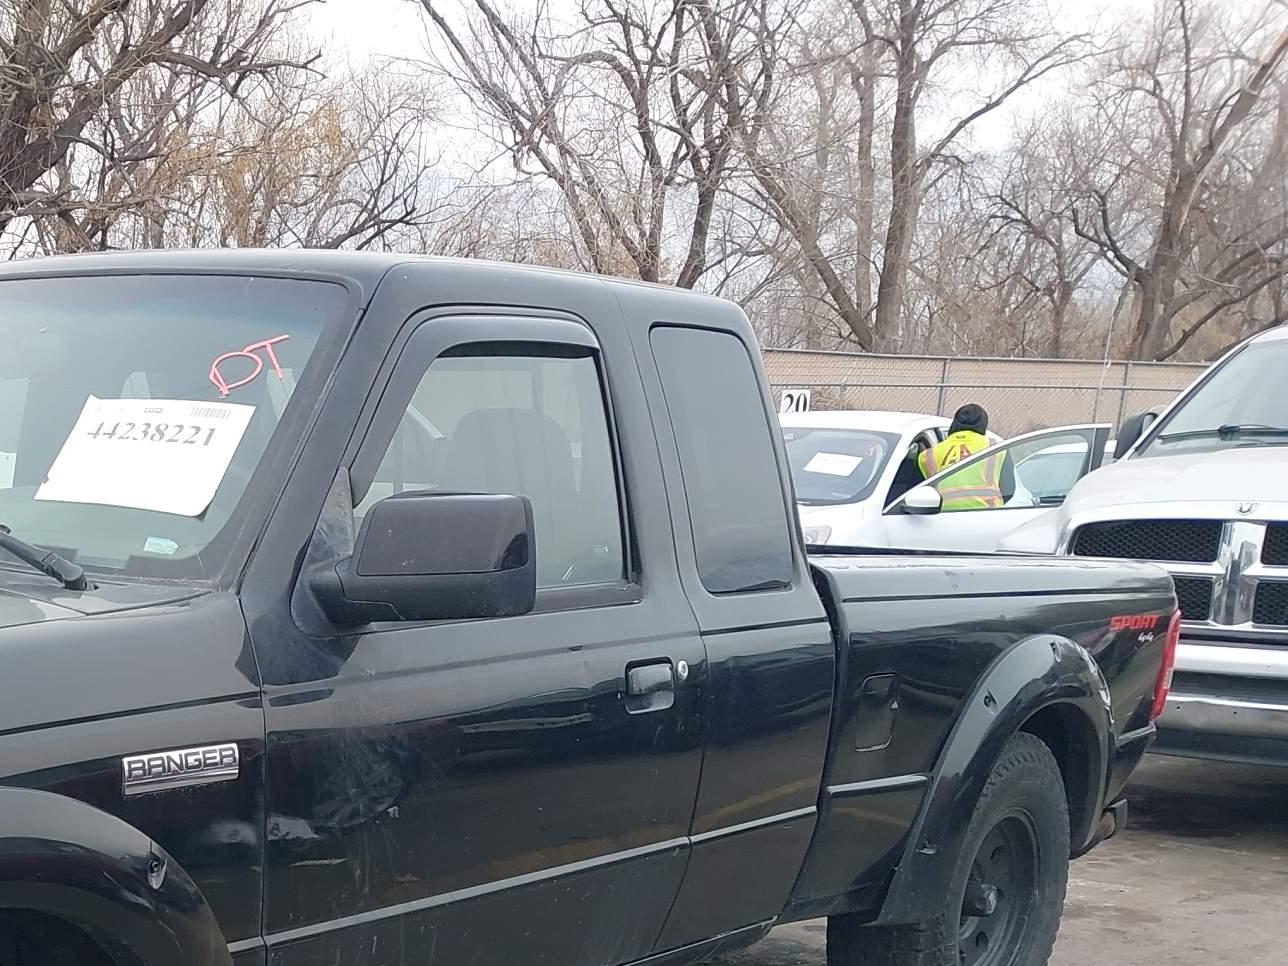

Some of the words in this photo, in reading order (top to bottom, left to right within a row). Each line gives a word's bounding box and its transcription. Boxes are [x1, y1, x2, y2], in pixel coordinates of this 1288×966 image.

[784, 393, 808, 413] 20
[87, 421, 216, 446] 44238221
[1110, 614, 1160, 631] SPORT
[127, 746, 238, 781] RANGER
